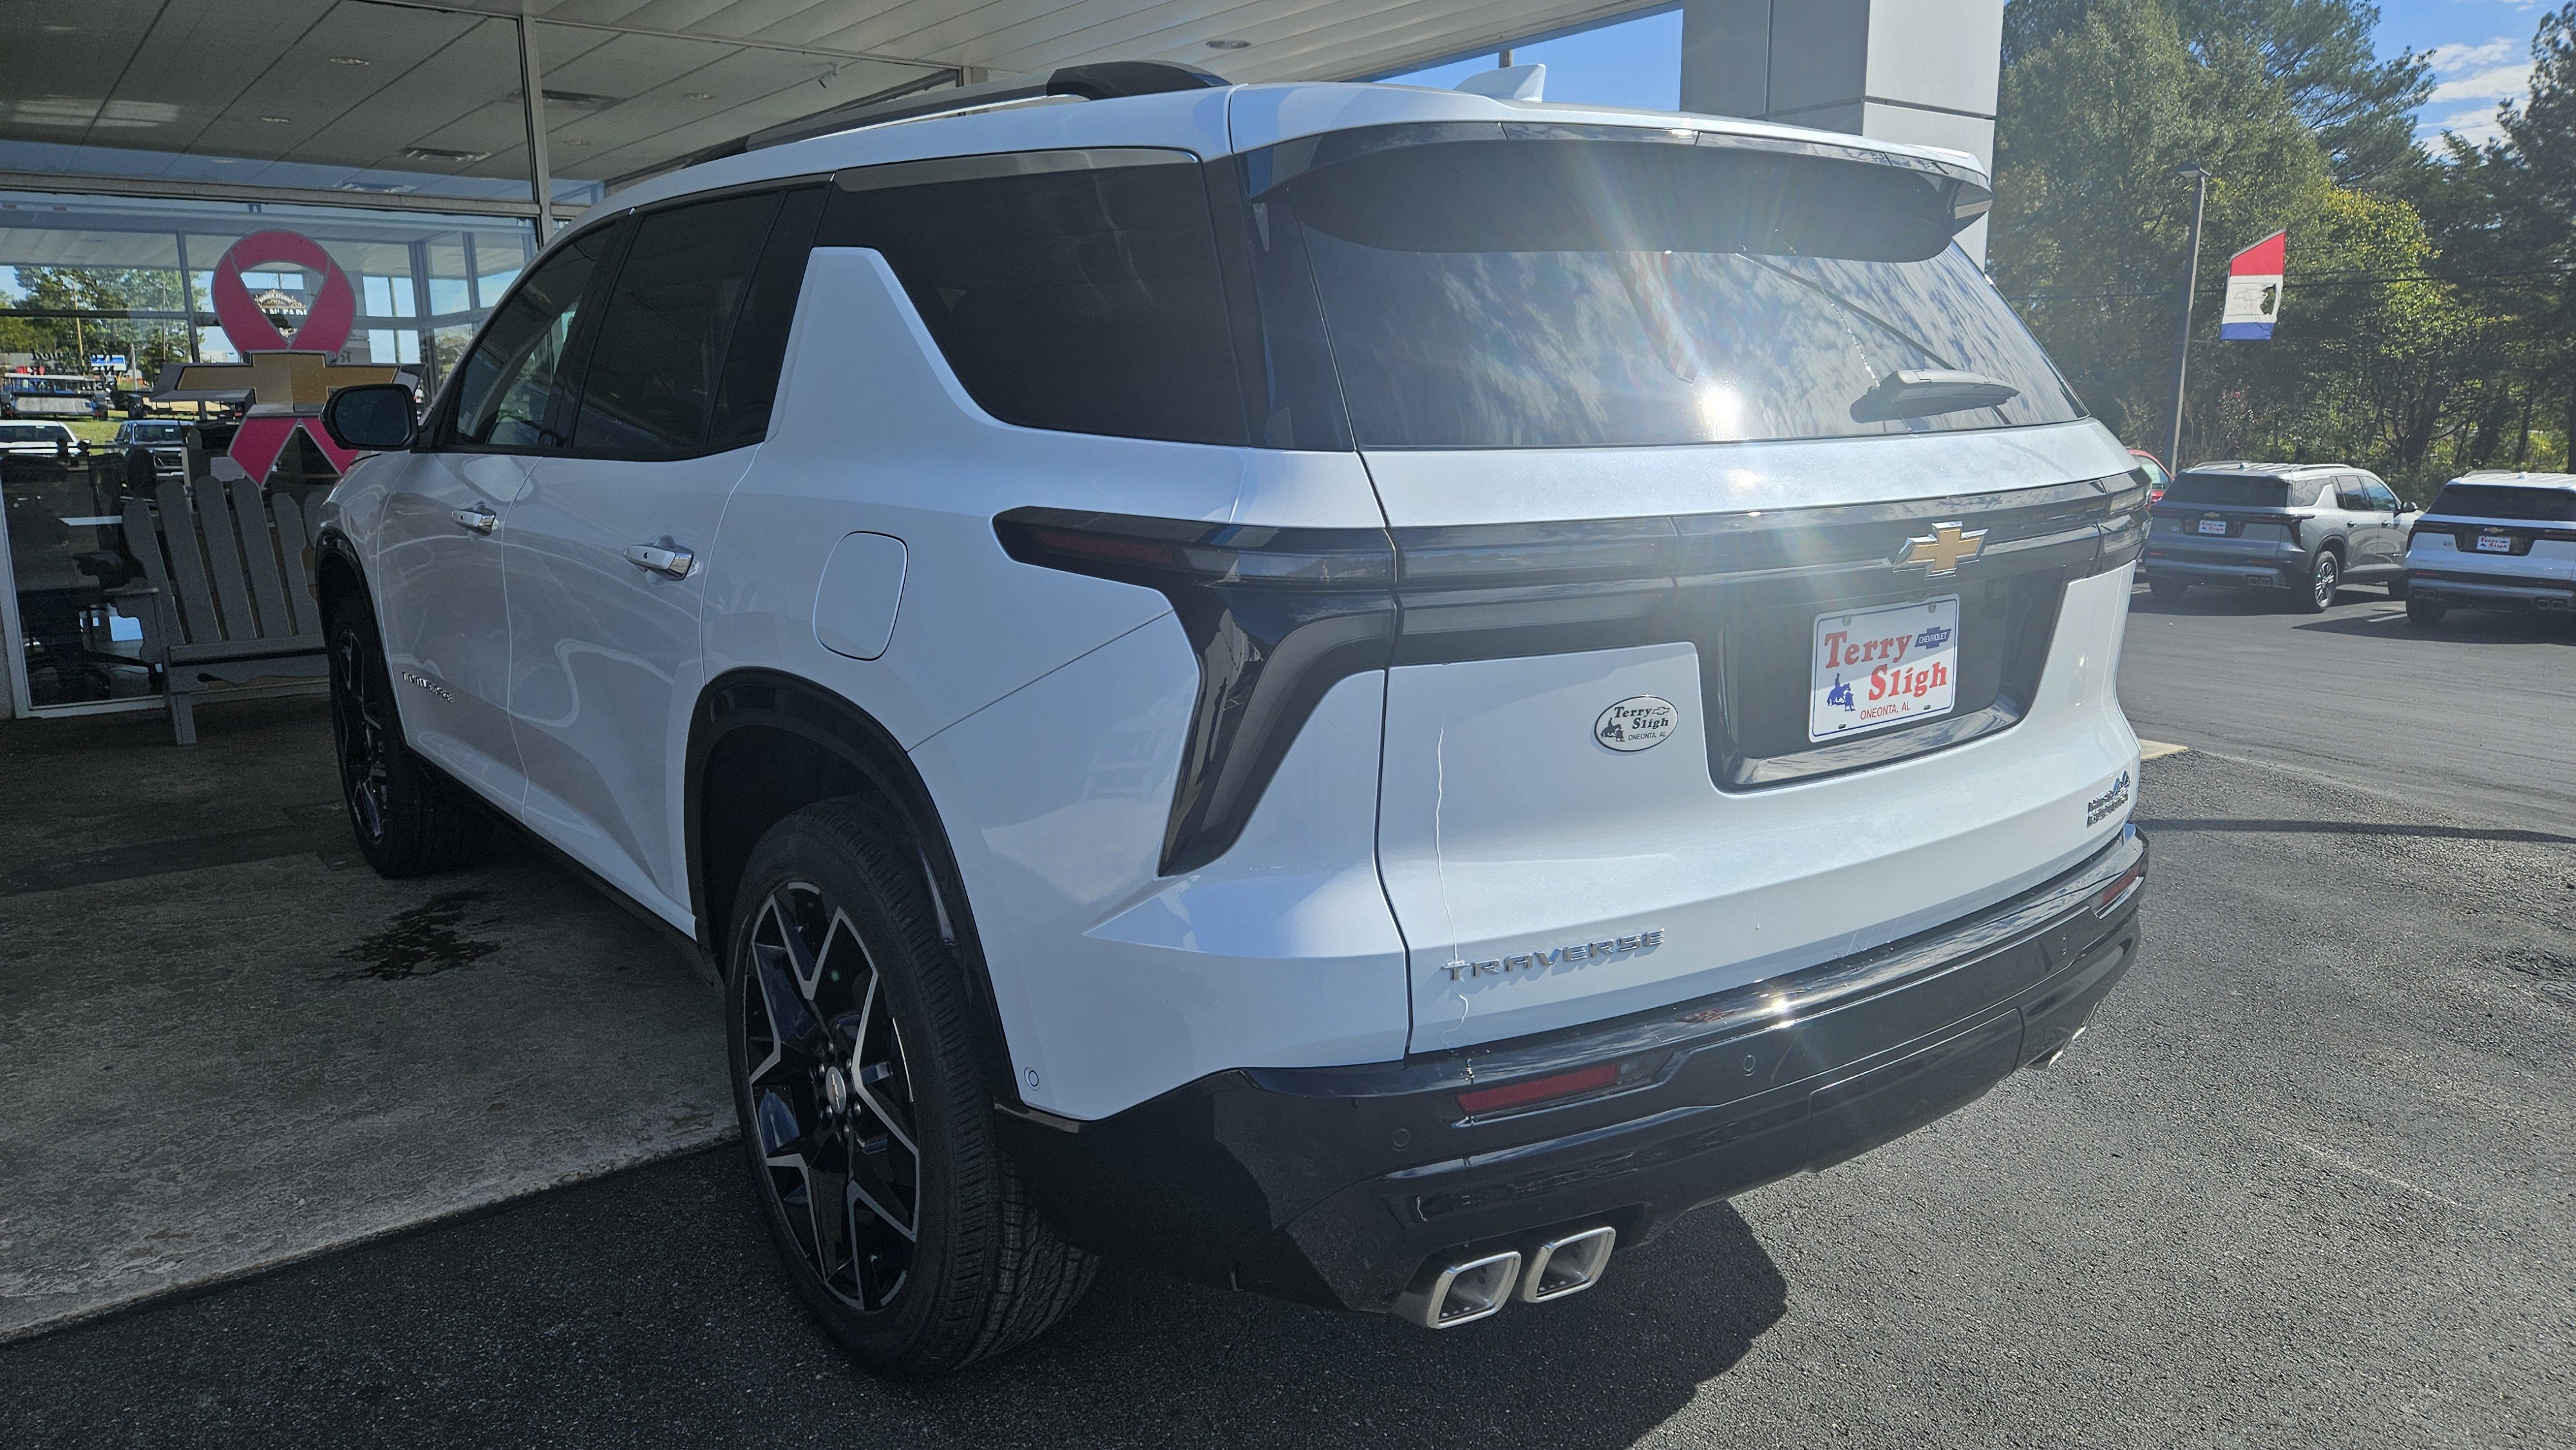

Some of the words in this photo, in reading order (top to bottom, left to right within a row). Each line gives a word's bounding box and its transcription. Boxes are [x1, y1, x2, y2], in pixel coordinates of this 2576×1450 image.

[1919, 632, 1947, 644] CHEVROLET
[1824, 631, 1913, 668] Terry
[1869, 661, 1947, 701] Sligh
[1614, 706, 1653, 718] Terry
[1861, 702, 1899, 720] ONEONTA,
[1901, 701, 1911, 711] AL
[1632, 717, 1669, 729] Sligh
[1443, 928, 1665, 981] TRAVERSE
